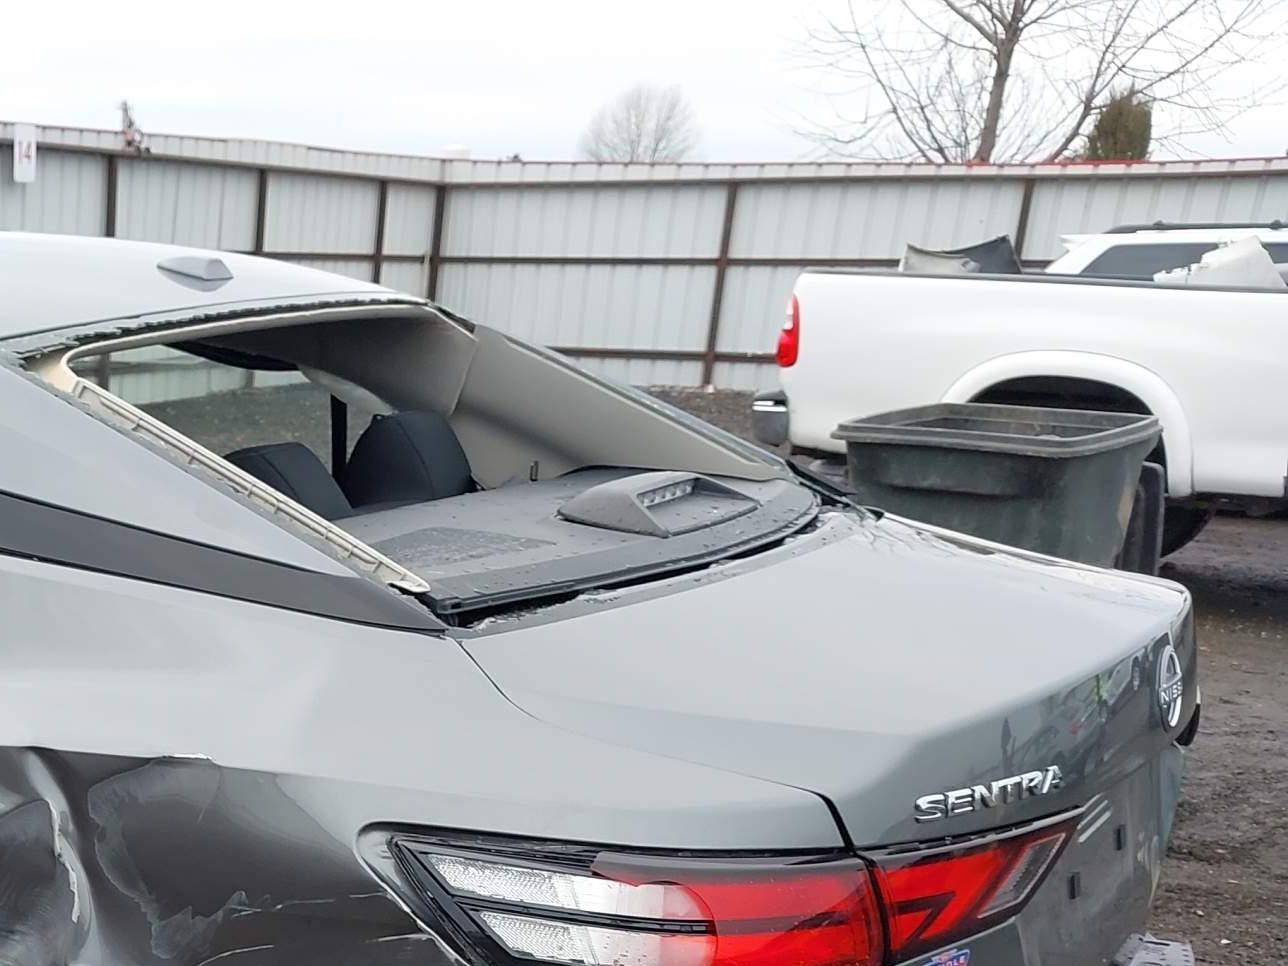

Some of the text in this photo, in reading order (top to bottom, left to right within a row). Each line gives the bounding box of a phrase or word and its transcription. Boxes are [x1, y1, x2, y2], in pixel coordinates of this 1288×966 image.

[17, 140, 33, 164] 14
[1160, 681, 1183, 704] NISS
[914, 765, 1064, 822] SENTRA
